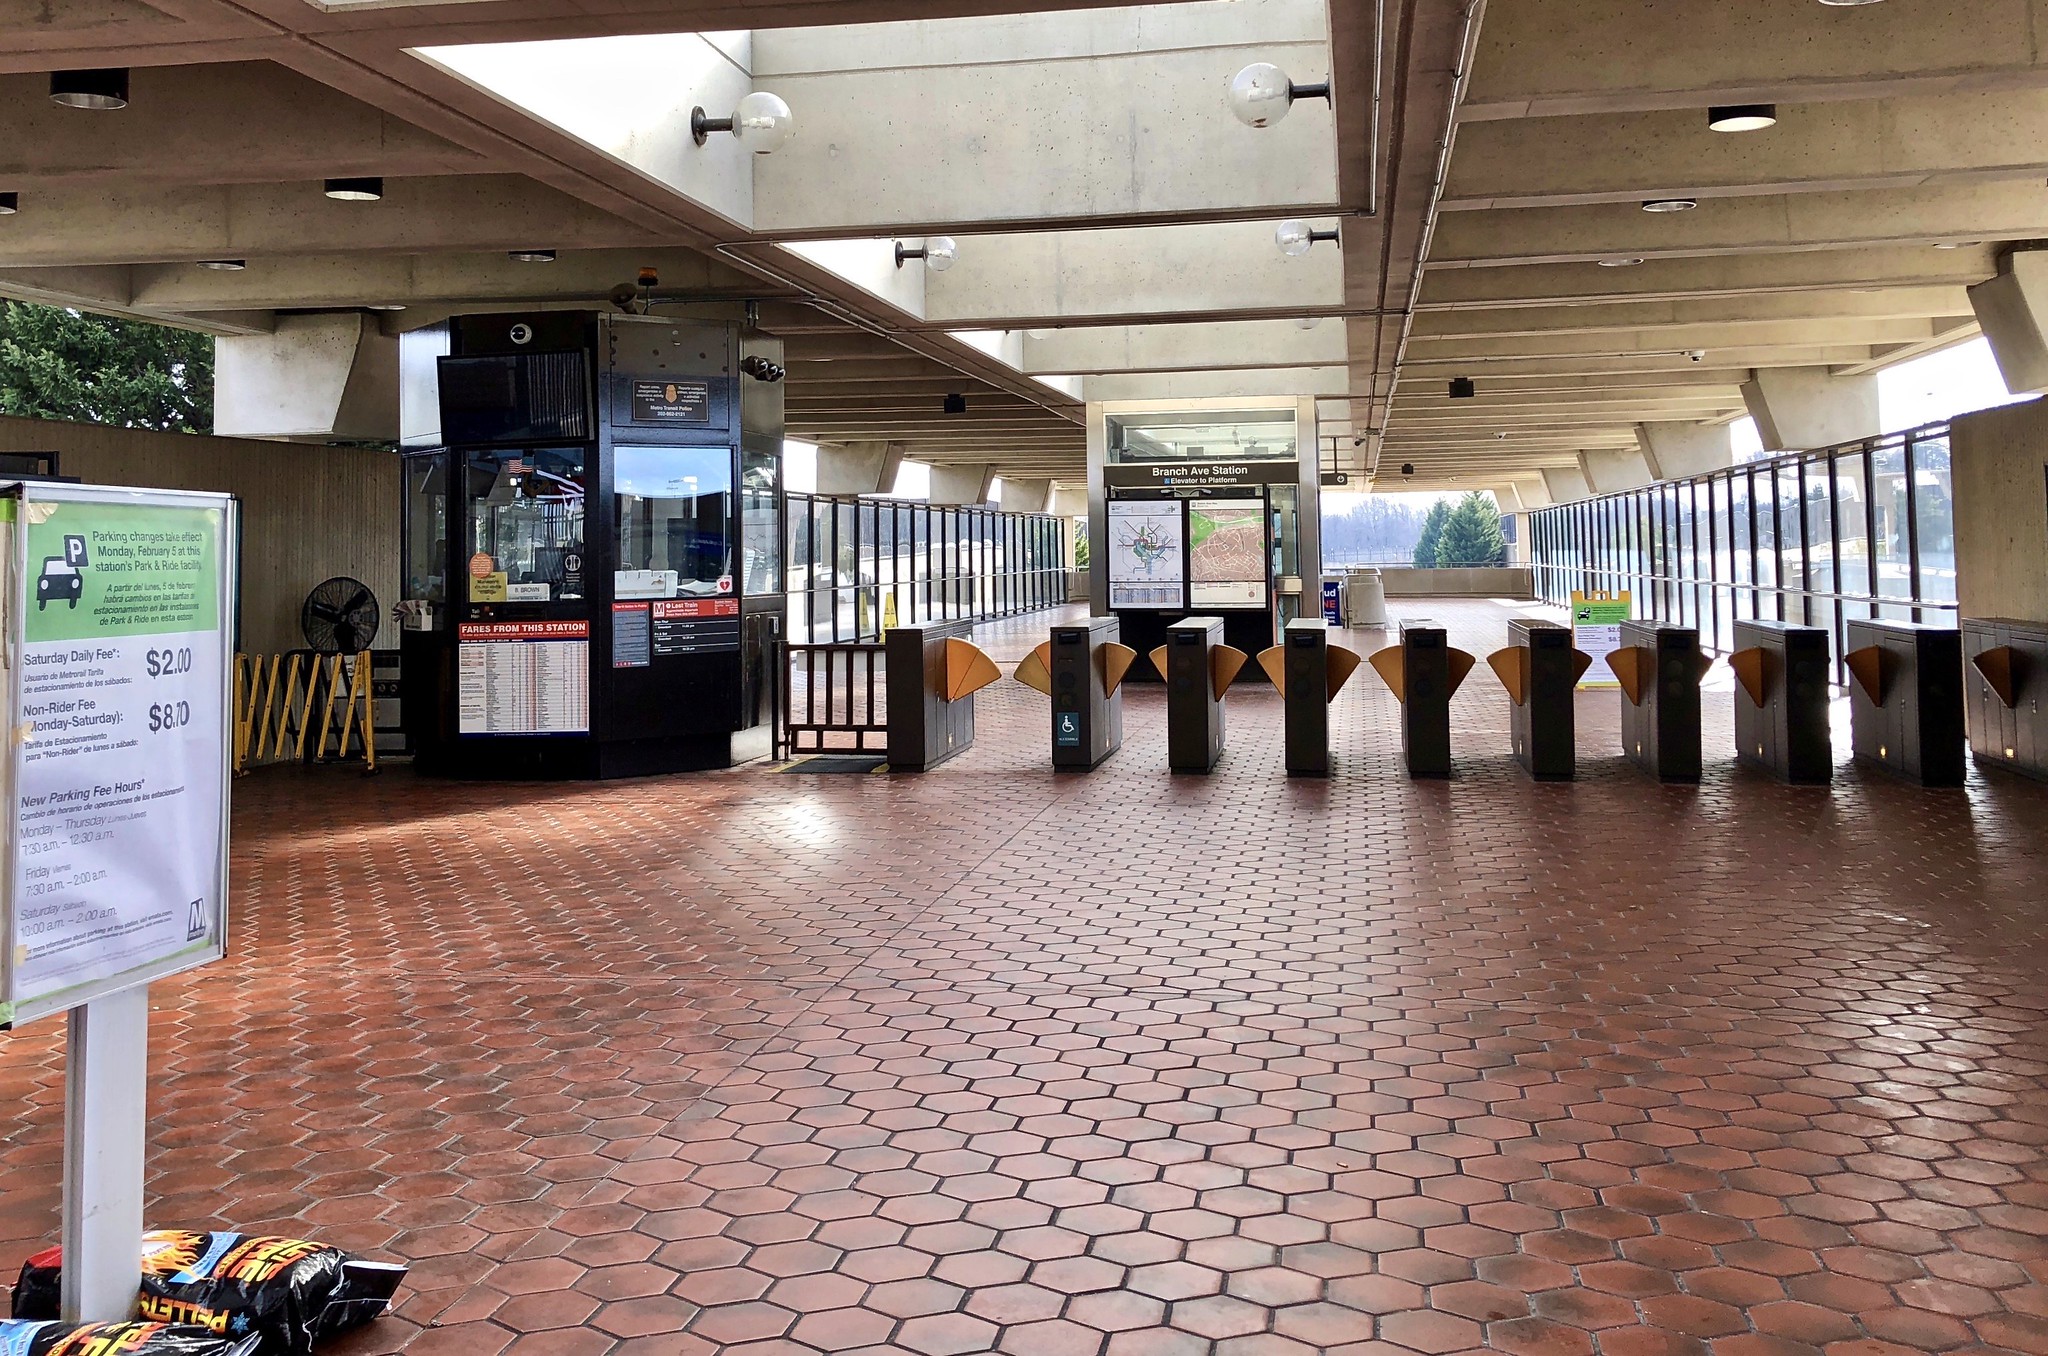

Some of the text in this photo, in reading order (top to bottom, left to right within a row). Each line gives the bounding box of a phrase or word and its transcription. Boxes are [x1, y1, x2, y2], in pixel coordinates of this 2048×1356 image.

[1152, 466, 1248, 476] Branch Ave Station
[92, 531, 202, 544] Parking changes take effect
[98, 546, 200, 558] Monday, February 5 at this
[96, 561, 132, 572] station's
[135, 560, 152, 571] Park
[155, 560, 160, 570] &
[162, 560, 178, 570] Ride
[107, 584, 112, 592] A
[114, 583, 132, 593] partir
[163, 582, 166, 590] 5
[168, 582, 174, 590] de
[125, 594, 152, 602] cambios
[94, 604, 148, 614] estacionamiento
[160, 603, 168, 611] las
[100, 617, 109, 625] de
[110, 617, 125, 625] Park
[127, 616, 132, 624] &
[134, 615, 149, 623] Ride
[462, 625, 491, 633] FARES
[546, 623, 585, 631] STATION
[24, 652, 68, 665] Saturday
[71, 649, 94, 662] Daily
[146, 647, 191, 679] $2.00
[24, 673, 48, 682] Usuario
[50, 672, 58, 680] de
[59, 669, 86, 679] Metrorail
[34, 682, 84, 693] estacionamiento
[94, 678, 103, 686] los
[23, 699, 96, 716] Non-Rider Fee
[30, 711, 123, 732] onday-Saturday):
[24, 733, 107, 750] Tarifa de Estacionamiento
[26, 752, 41, 762] para
[84, 745, 91, 753] de
[93, 742, 110, 752] lunes
[21, 796, 46, 808] New
[49, 790, 90, 804] Parking
[94, 786, 112, 797] Fee
[21, 810, 45, 821] Cambio
[58, 806, 82, 814] horario
[94, 798, 132, 810] operaciones
[20, 824, 54, 839] Monday
[65, 815, 106, 829] Thursday
[22, 843, 40, 855] 7:30
[26, 866, 51, 880] Friday
[26, 883, 45, 896] 7:30
[74, 872, 90, 885] 2:00
[20, 904, 60, 920] Saturday
[20, 922, 44, 937] 10:00
